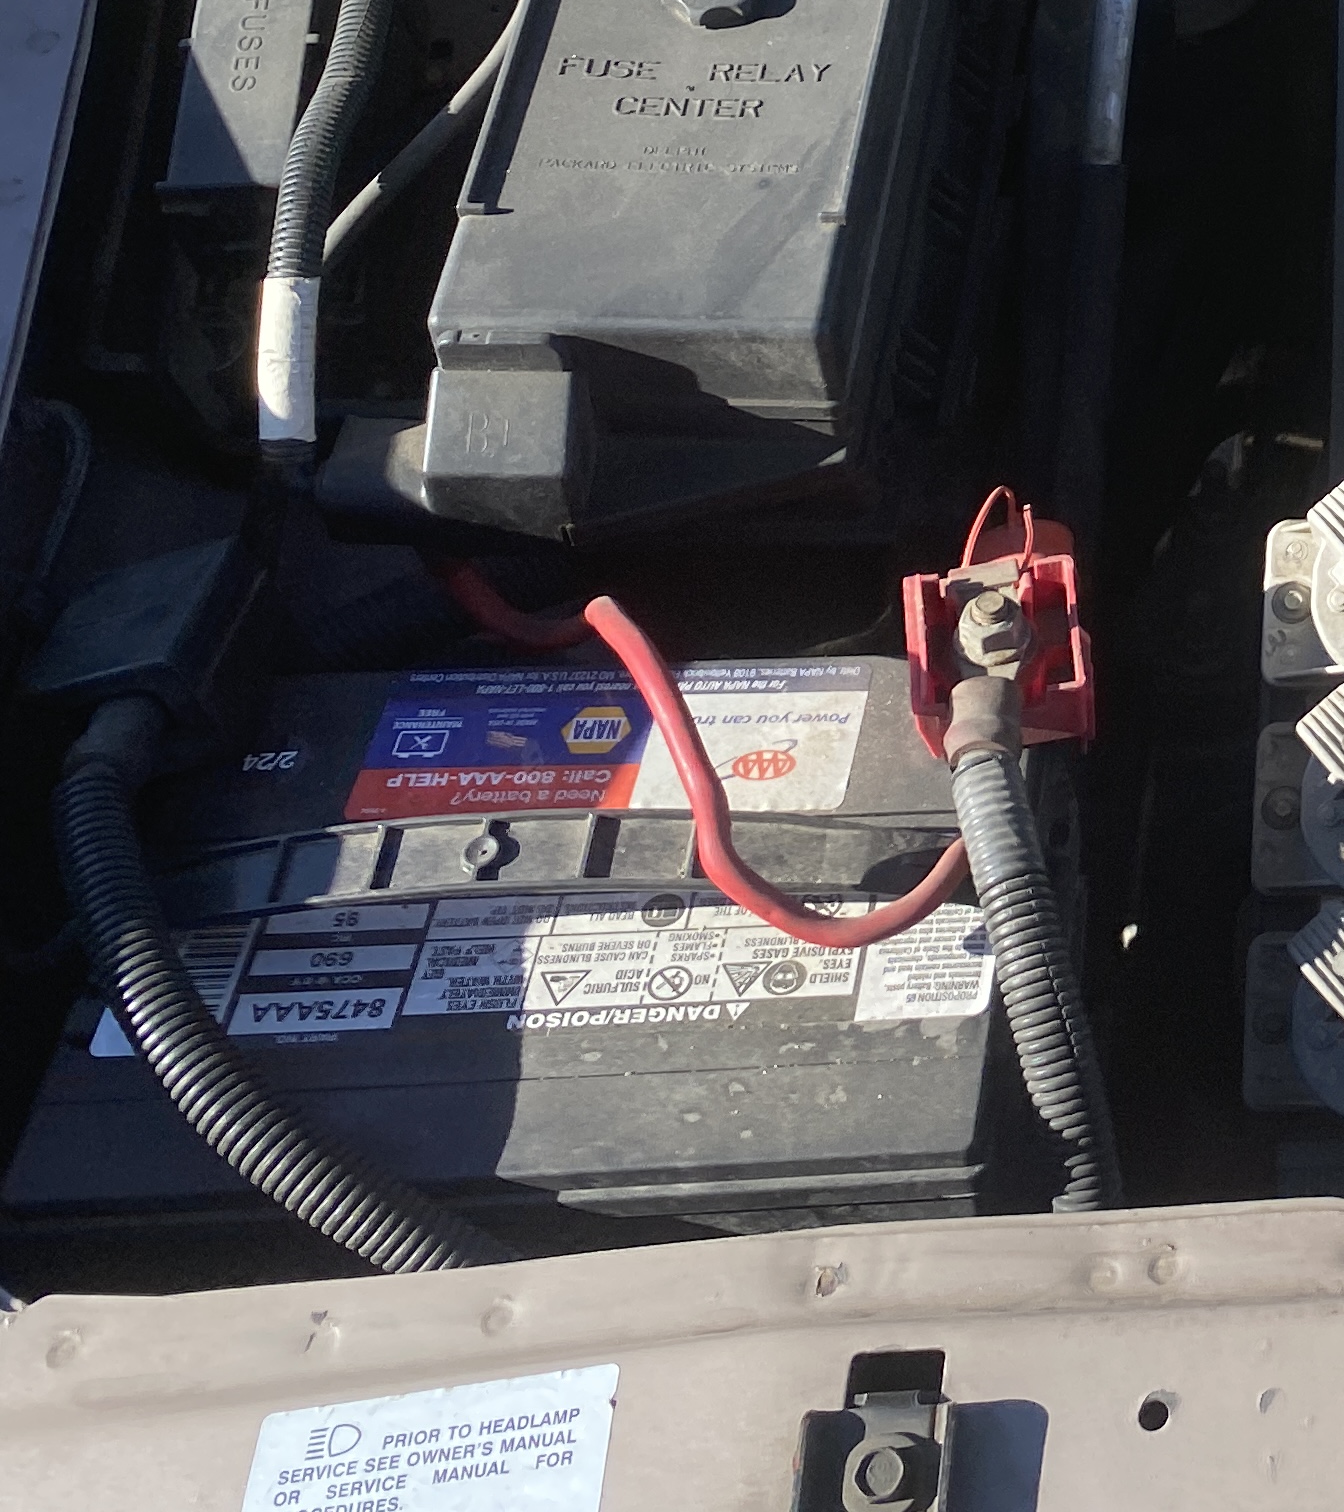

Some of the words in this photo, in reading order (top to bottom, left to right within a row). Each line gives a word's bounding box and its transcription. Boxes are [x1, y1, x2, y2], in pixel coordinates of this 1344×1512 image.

[557, 57, 661, 80] FUSE
[709, 63, 832, 83] RELAY
[614, 96, 764, 119] CENTER
[692, 680, 720, 690] AUTO
[722, 680, 749, 690] NAPA
[417, 708, 446, 717] FREE
[722, 714, 751, 724] can
[756, 711, 790, 724] you
[796, 712, 850, 726] Power
[393, 720, 463, 730] MAINTENANCE
[572, 719, 622, 740] NAPA
[242, 750, 298, 771] 2/24
[744, 754, 791, 778] AAA
[386, 770, 556, 787] 800-AAA-HELP
[563, 769, 611, 783] Call:
[450, 788, 532, 805] battery?
[538, 789, 549, 801] a
[555, 789, 605, 804] Need
[333, 911, 360, 927] 95
[599, 940, 634, 952] SEVERE
[637, 939, 651, 952] OR
[309, 951, 354, 968] 690
[538, 953, 592, 966] BLINDNESS
[595, 952, 628, 964] CAUSE
[630, 951, 649, 964] CAN
[752, 947, 790, 960] GASES
[616, 969, 644, 981] ACID
[694, 974, 711, 986] NO
[809, 972, 850, 984] SHIELD
[583, 981, 641, 996] SULFURIC
[917, 991, 978, 1002] PROPOSITION
[251, 997, 387, 1023] 8475AAA
[506, 1004, 722, 1030] DANGER/POISON
[382, 1428, 441, 1450] PRIOR
[448, 1424, 472, 1440] TO
[478, 1408, 580, 1436] HEADLAMP
[277, 1460, 358, 1486] SERVICE
[364, 1455, 401, 1473] SEE
[406, 1441, 493, 1467] OWNER'S
[499, 1428, 577, 1454] MANUAL
[273, 1490, 300, 1507] OR
[326, 1475, 407, 1500] SERVICE
[432, 1460, 510, 1485] MANUAL
[535, 1451, 574, 1470] FOR
